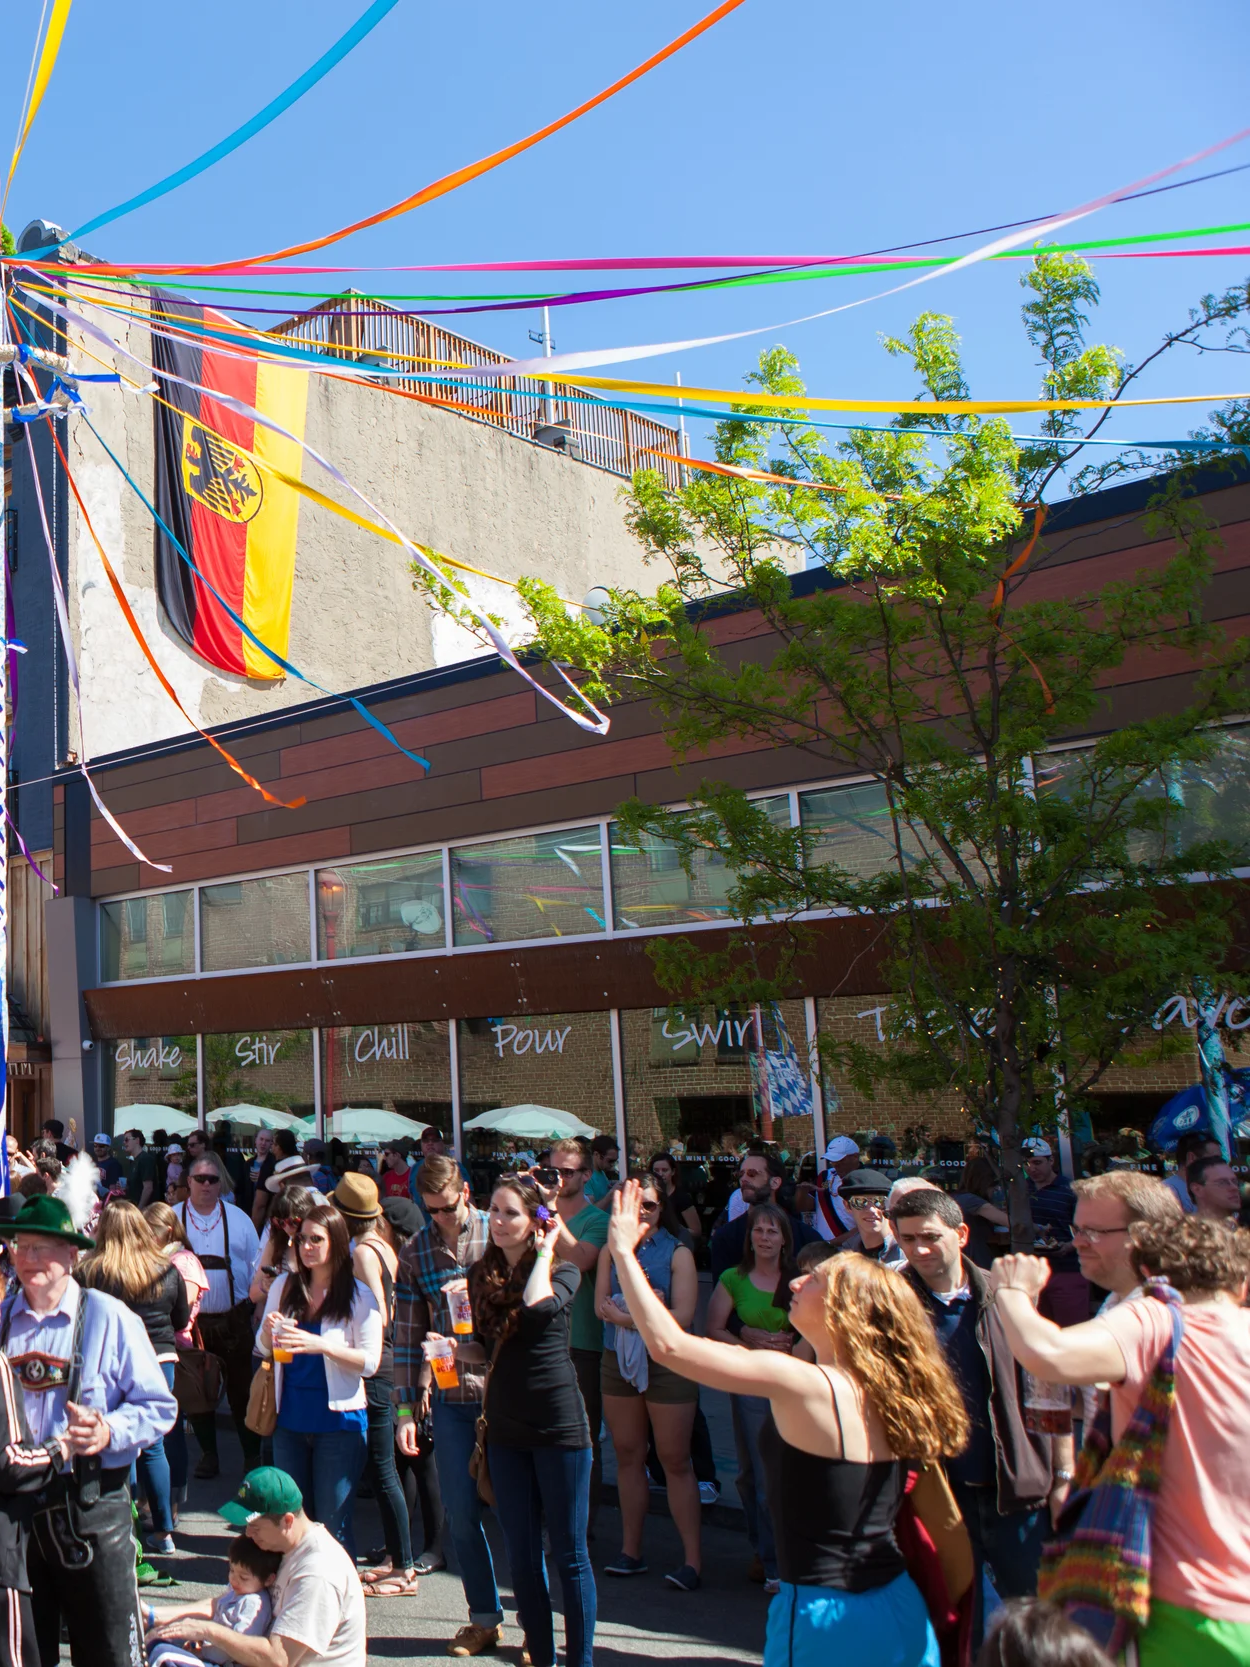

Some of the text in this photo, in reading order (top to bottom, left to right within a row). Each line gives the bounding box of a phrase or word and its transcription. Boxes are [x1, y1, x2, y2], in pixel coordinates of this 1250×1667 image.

[115, 1041, 183, 1072] Shake
[235, 1036, 281, 1068] Stir
[354, 1023, 410, 1063] Chill
[491, 1023, 573, 1058] Pour
[1130, 1163, 1158, 1171] FINE
